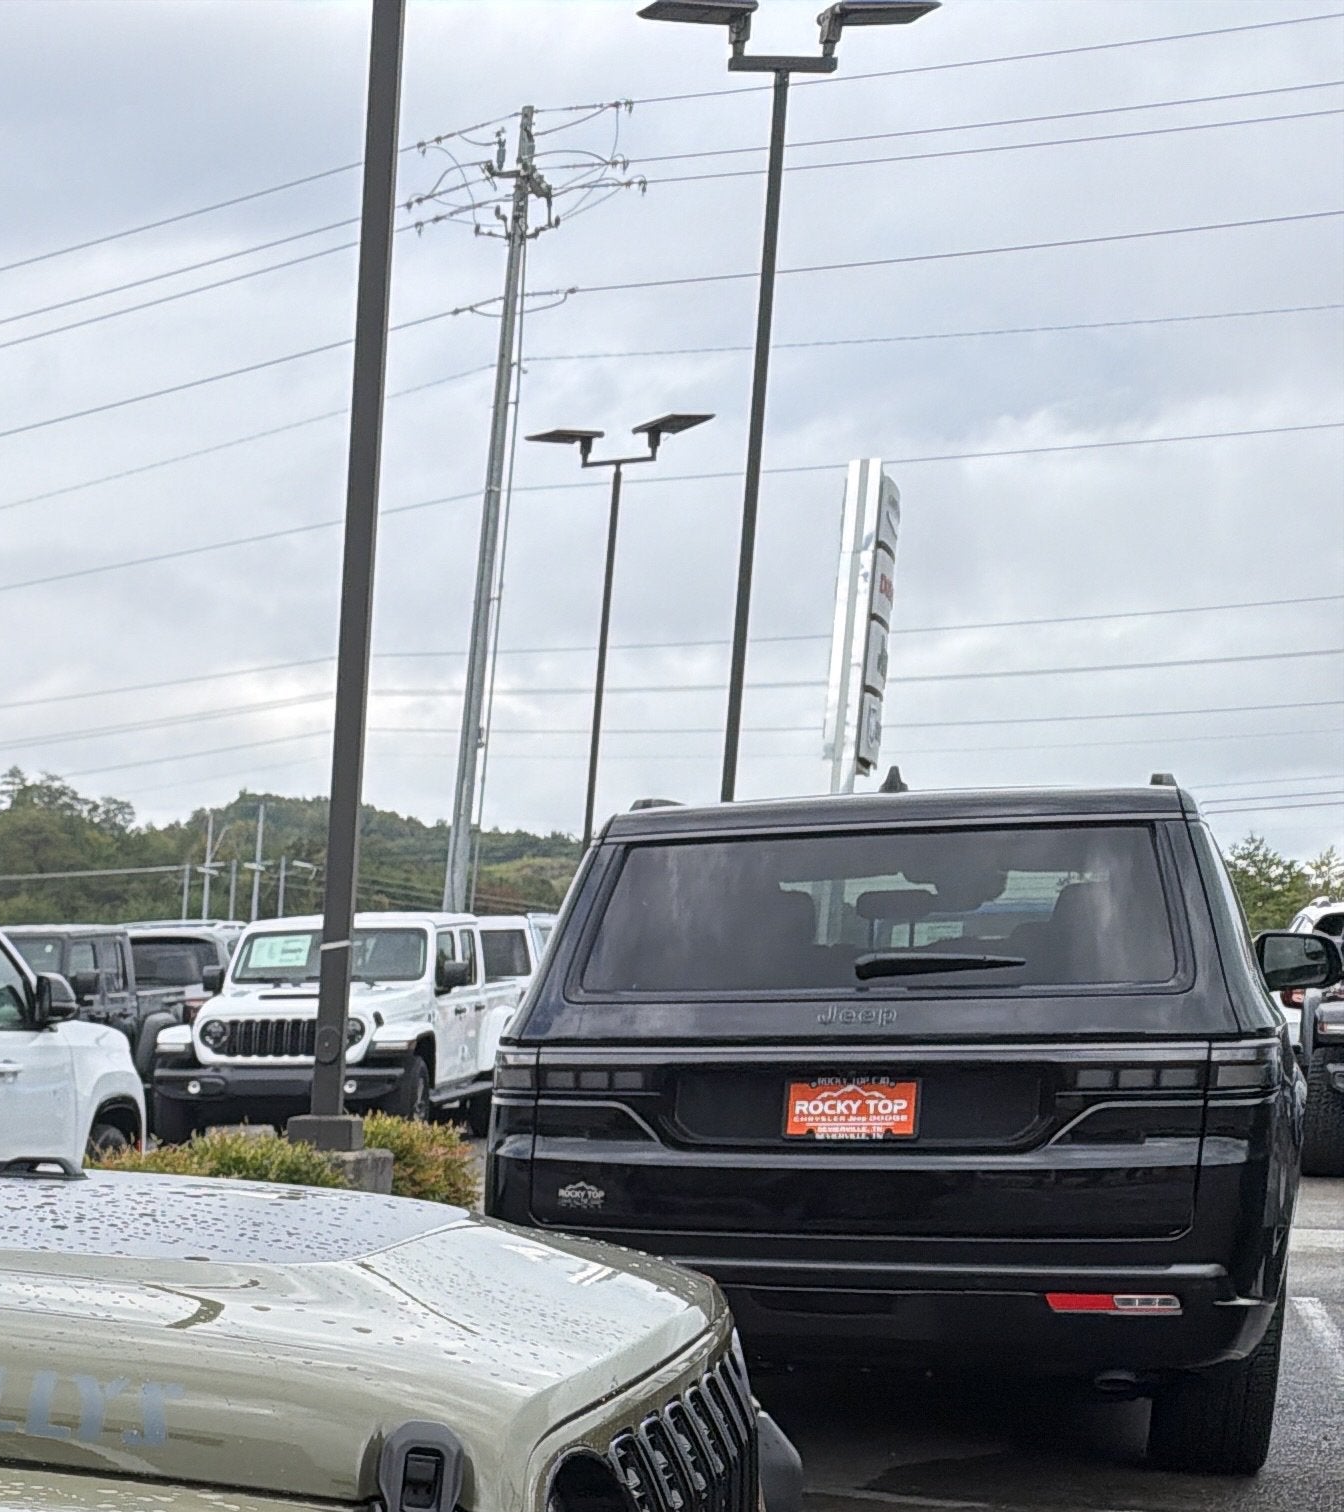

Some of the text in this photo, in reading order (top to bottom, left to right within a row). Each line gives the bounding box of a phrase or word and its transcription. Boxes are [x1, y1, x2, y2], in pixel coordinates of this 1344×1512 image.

[816, 1004, 898, 1026] Jeep
[794, 1099, 908, 1115] ROCKY TOP
